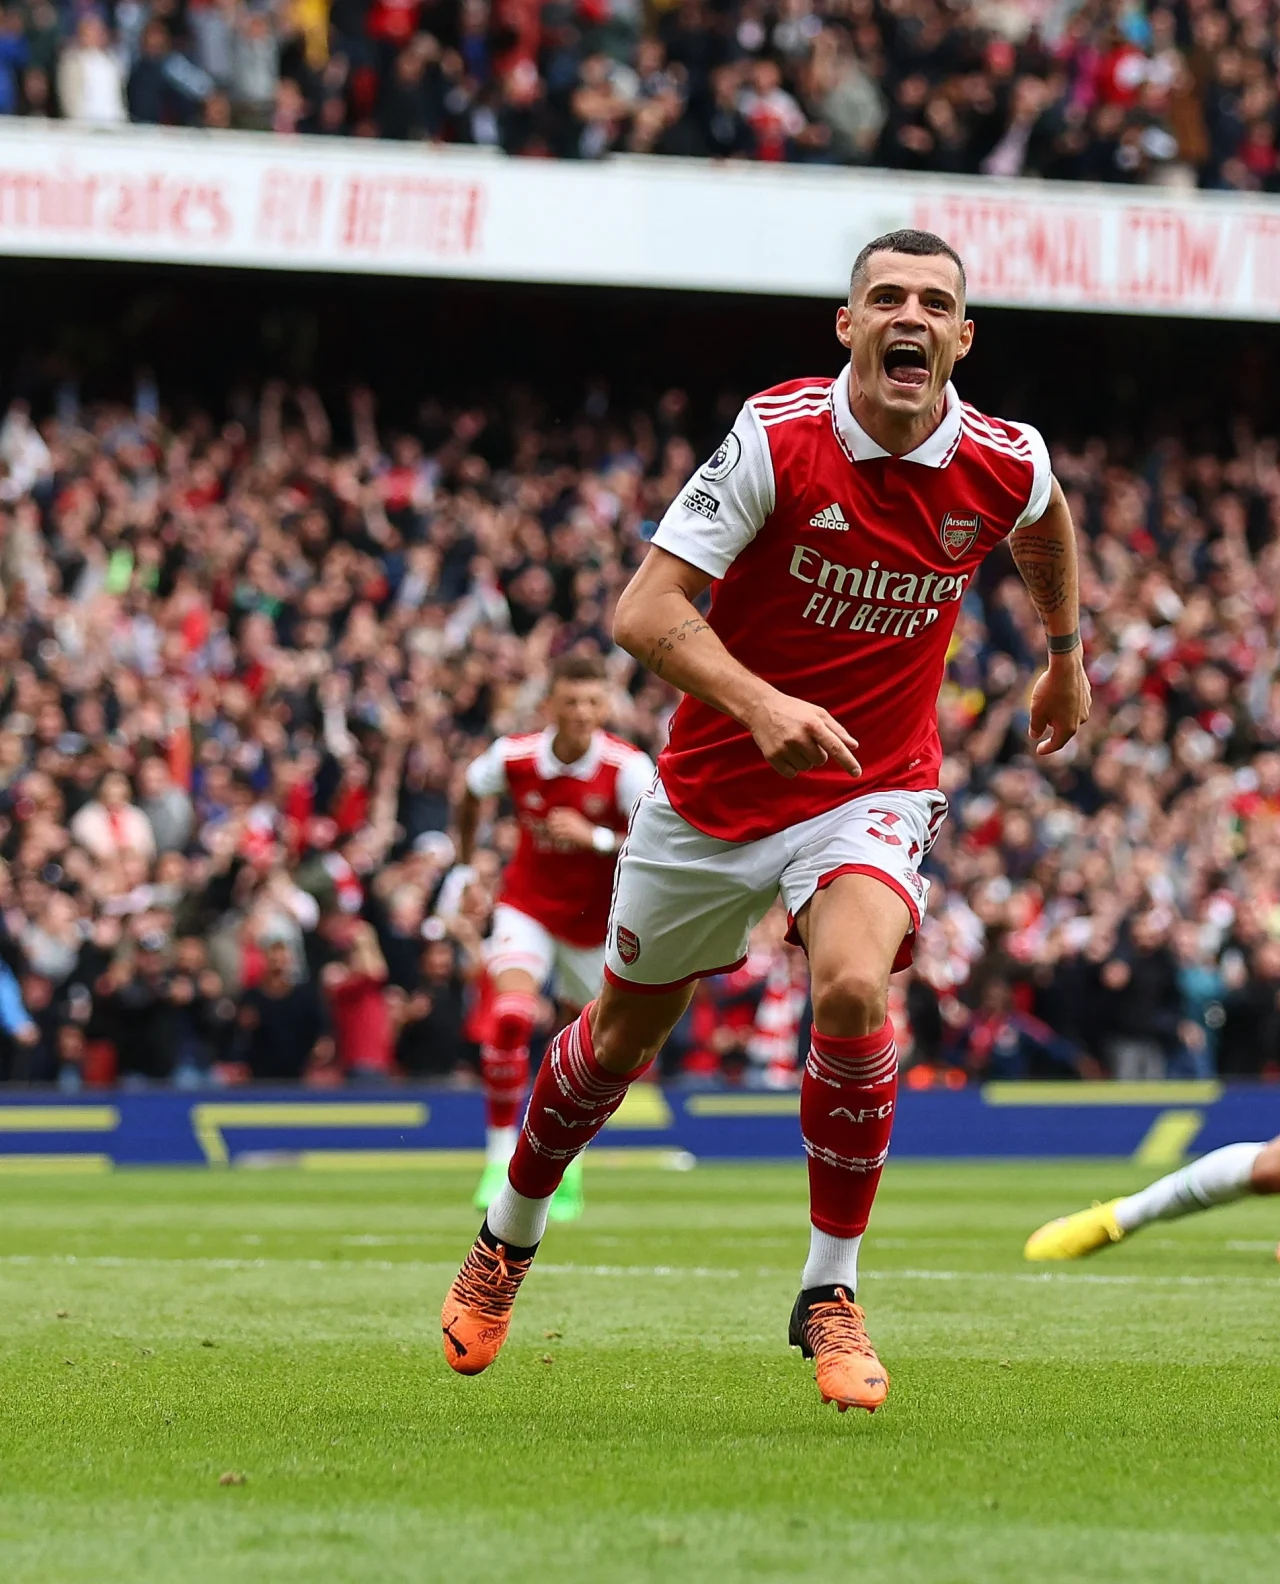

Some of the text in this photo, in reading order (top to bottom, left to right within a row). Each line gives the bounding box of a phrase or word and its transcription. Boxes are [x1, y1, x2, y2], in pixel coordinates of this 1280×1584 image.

[256, 166, 325, 247] FLY
[337, 172, 485, 255] BETTER
[809, 516, 850, 532] adidas
[946, 517, 976, 527] Arsenal
[789, 544, 969, 604] Emirates
[802, 592, 851, 628] FLY
[828, 1100, 893, 1123] AFC
